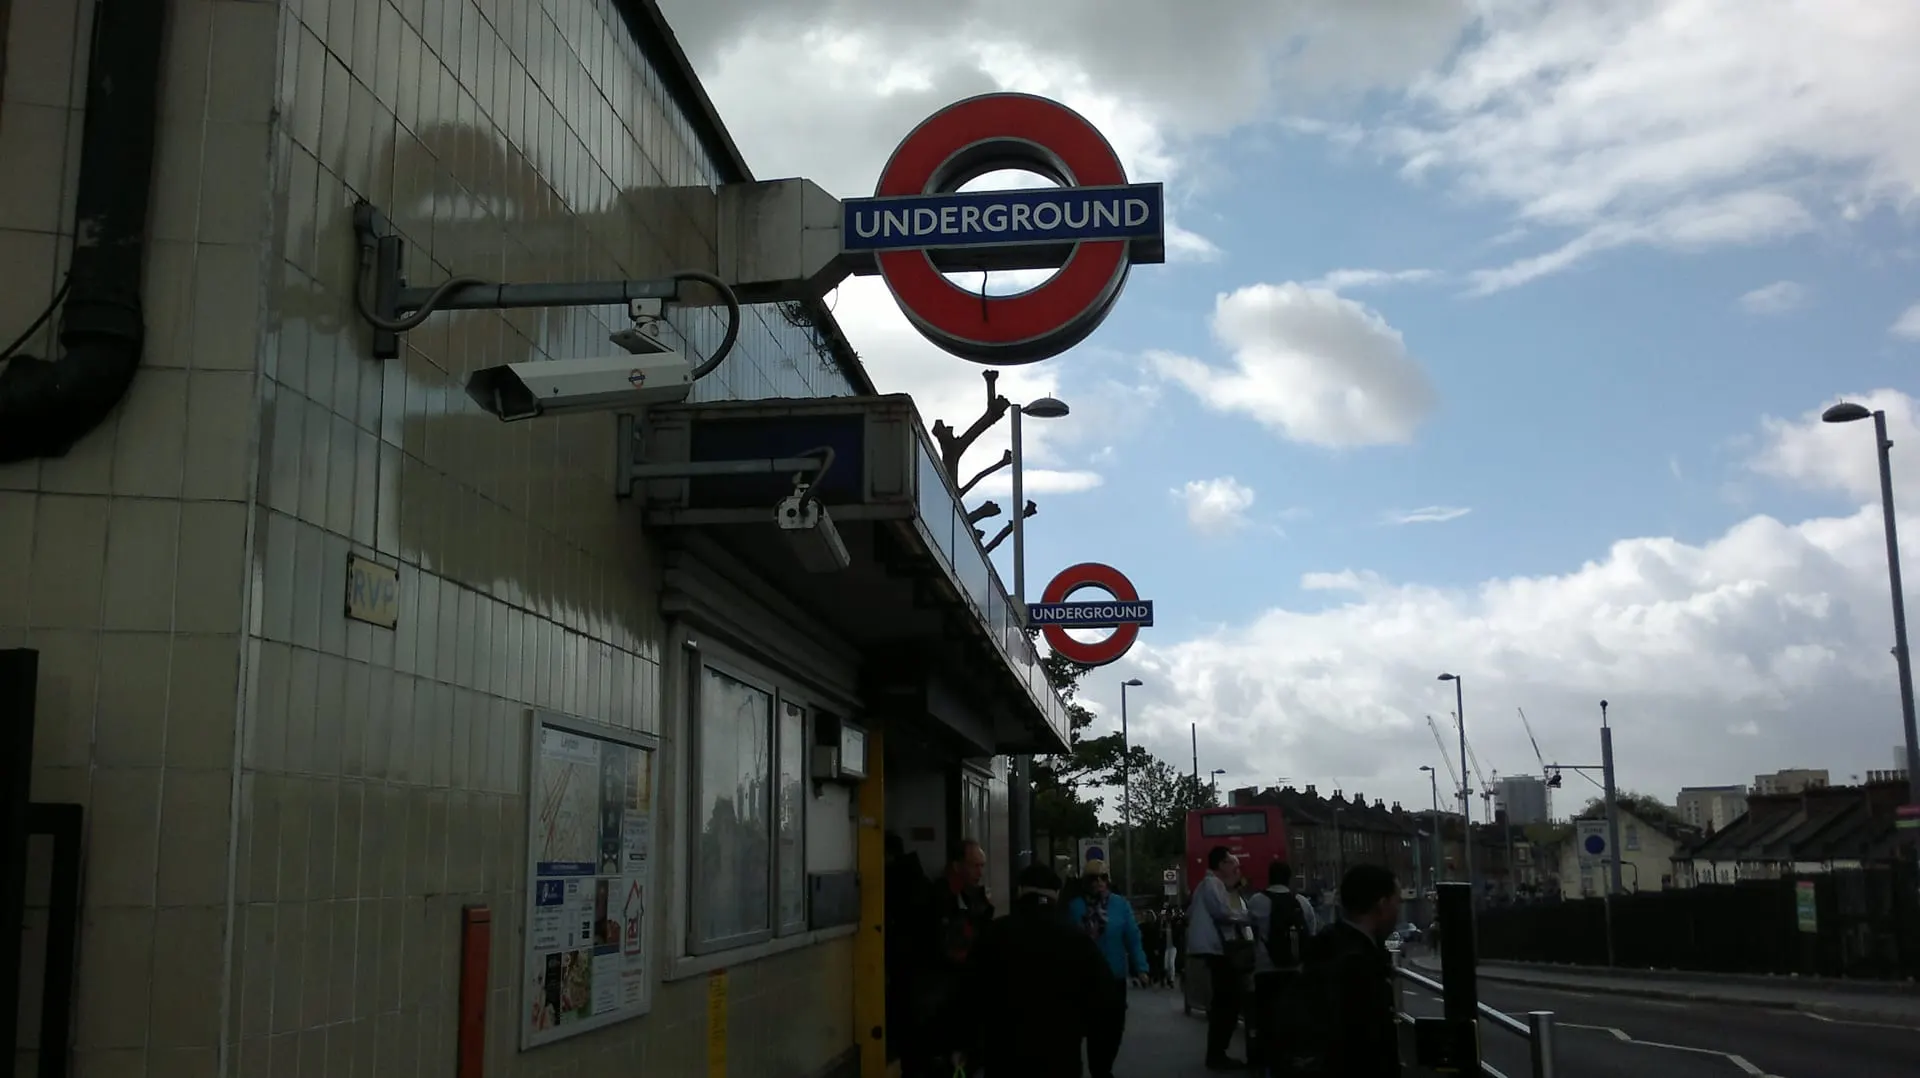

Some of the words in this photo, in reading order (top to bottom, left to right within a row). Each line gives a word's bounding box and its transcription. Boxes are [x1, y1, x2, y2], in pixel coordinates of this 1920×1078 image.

[855, 198, 1150, 238] UNDERGROUND
[353, 568, 394, 614] RVP
[1032, 606, 1148, 620] UNDERGROUND
